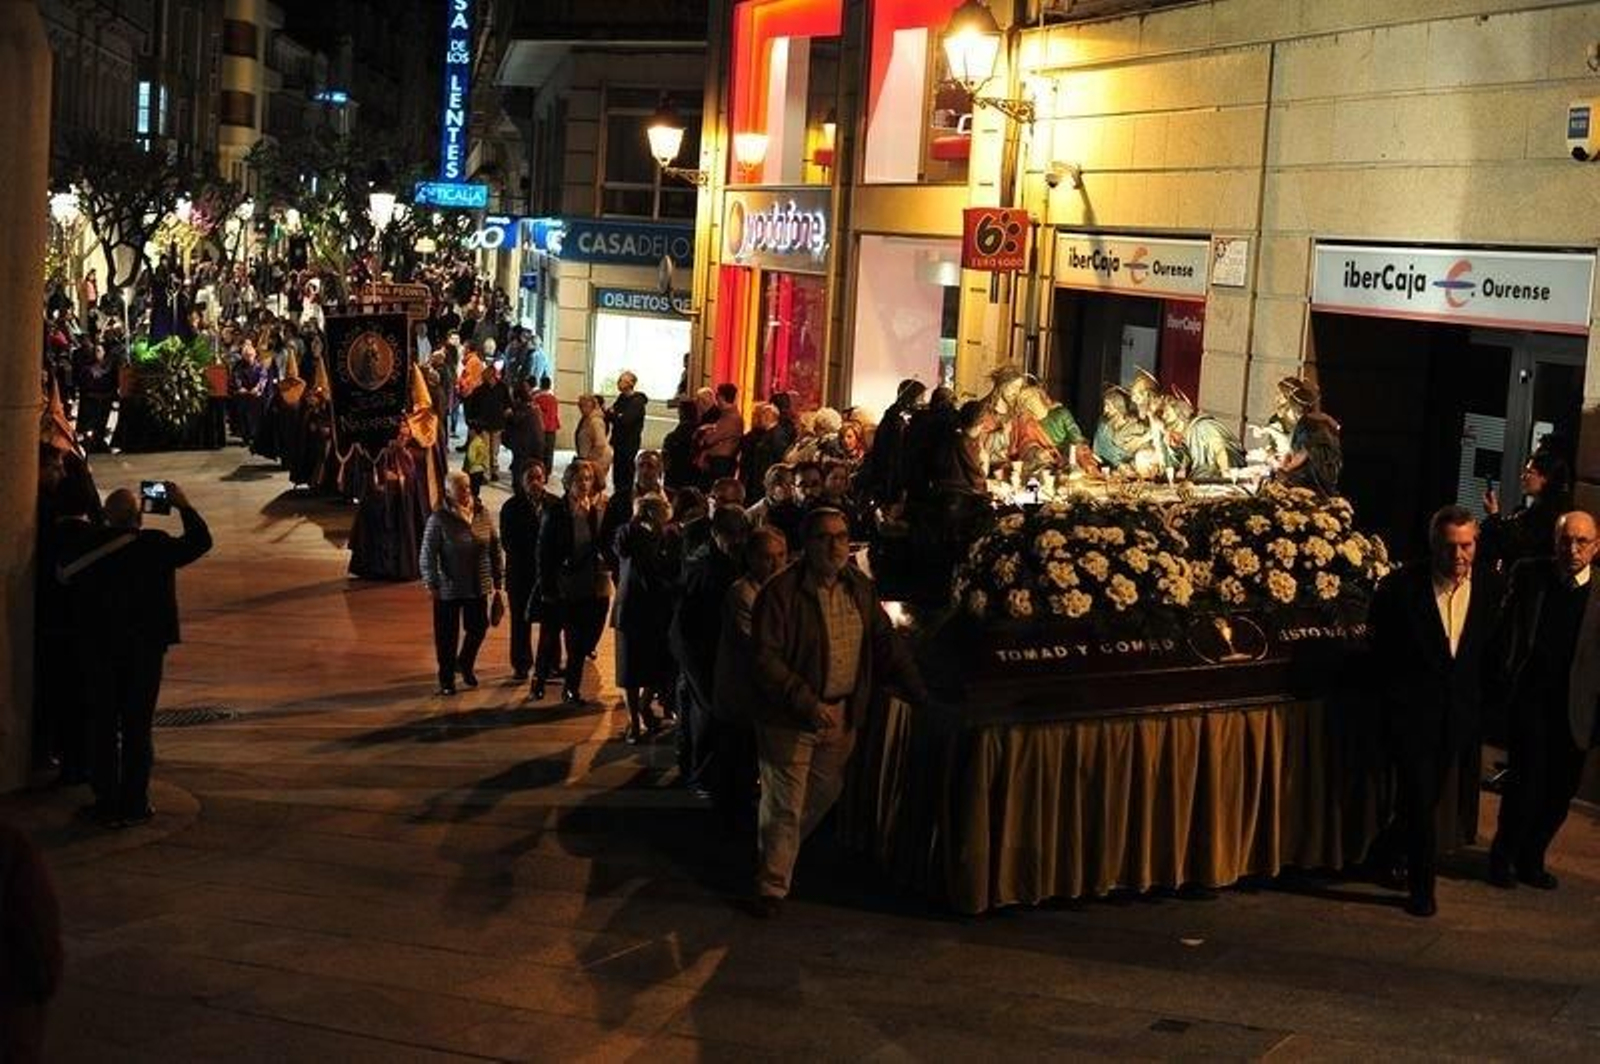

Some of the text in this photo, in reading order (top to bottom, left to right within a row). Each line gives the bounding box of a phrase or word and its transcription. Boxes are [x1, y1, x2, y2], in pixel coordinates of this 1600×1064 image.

[447, 51, 470, 64] LOS
[451, 40, 467, 52] DE
[446, 75, 464, 179] LENTES
[746, 200, 826, 252] vodafone
[1069, 247, 1120, 278] iberCaja
[1153, 260, 1194, 278] Ourense
[1343, 260, 1550, 300] iberCaja Ourense
[604, 292, 670, 311] OBJETOS
[995, 644, 1068, 662] TOMAD
[1076, 644, 1088, 656] Y
